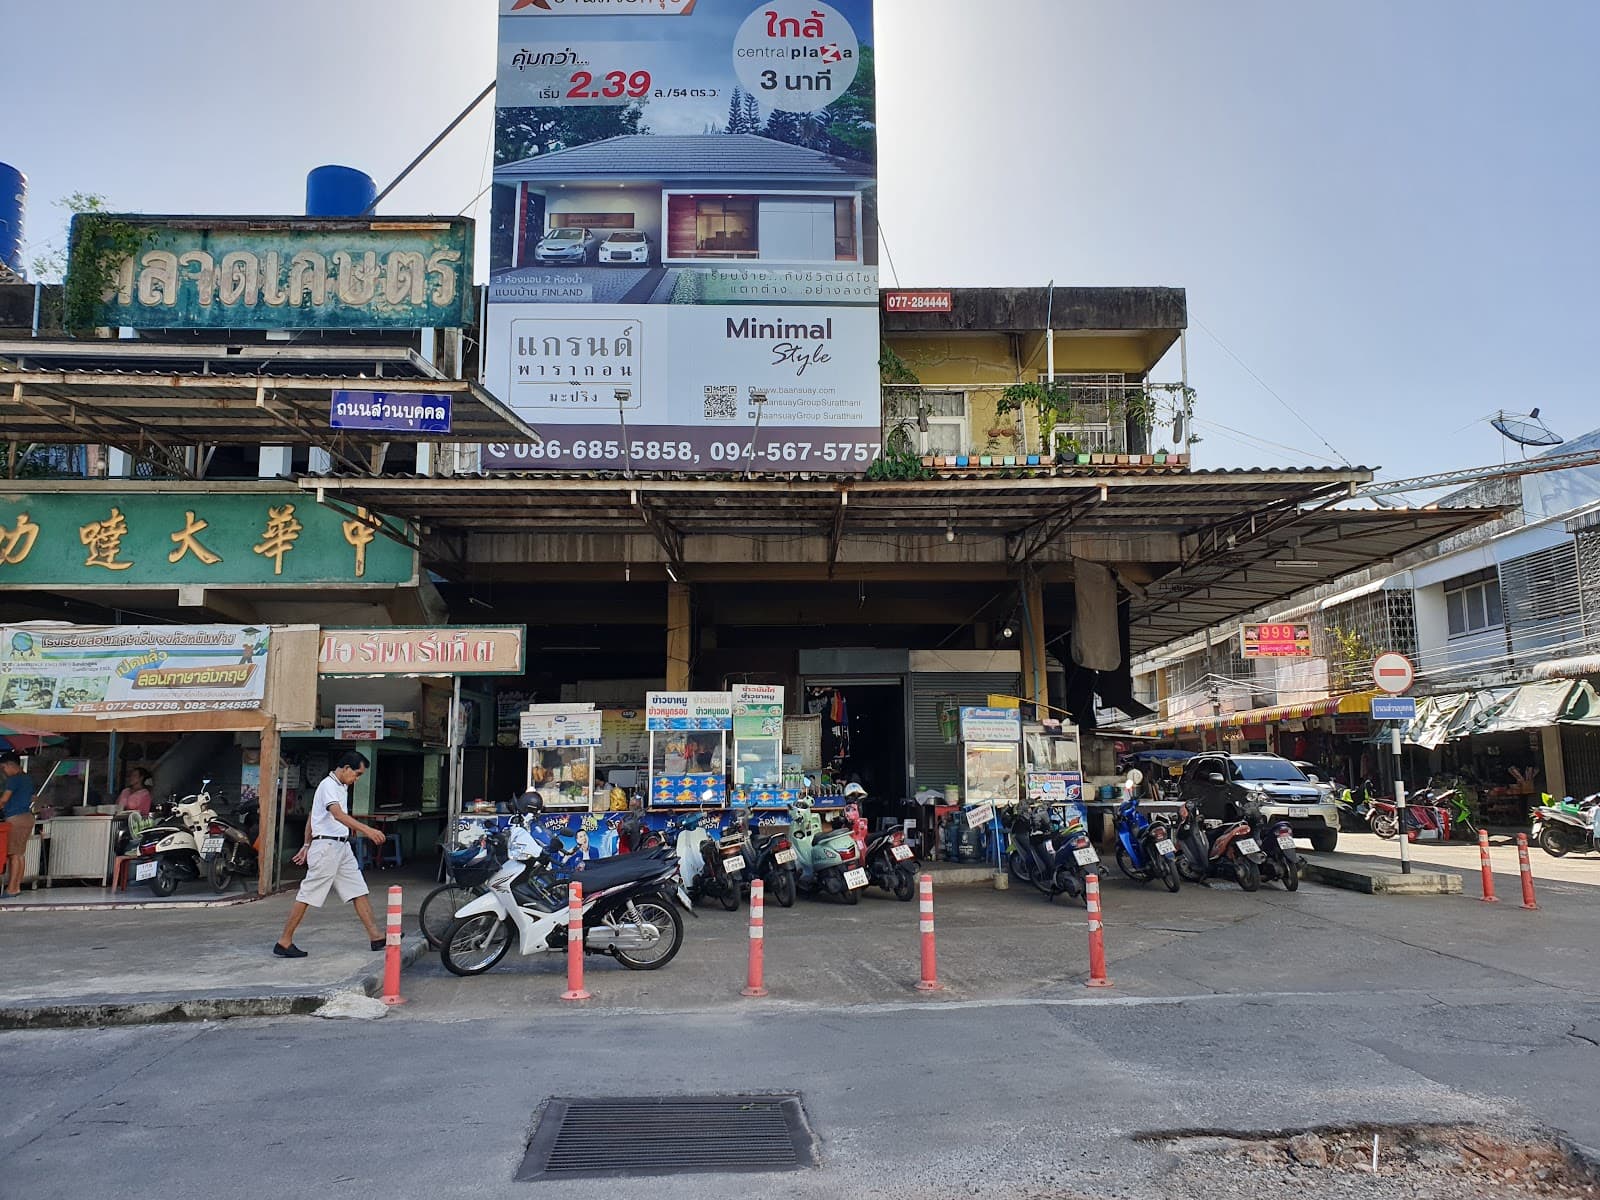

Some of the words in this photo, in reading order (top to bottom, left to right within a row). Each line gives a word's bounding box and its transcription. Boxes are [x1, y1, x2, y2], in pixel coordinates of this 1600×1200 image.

[765, 11, 825, 38] ใกล้
[737, 43, 853, 64] centralplaza
[539, 86, 560, 99] เริ่ม
[566, 71, 651, 99] 2.39
[760, 70, 777, 91] 3
[785, 69, 832, 91] นาที
[495, 286, 538, 297] แบบบ้าน
[541, 288, 583, 297] FINLAND
[888, 295, 949, 308] 077-284444
[726, 318, 832, 340] Minimal
[518, 326, 633, 357] แกรนด์
[771, 342, 832, 376] Style
[518, 365, 633, 377] พารากอน
[549, 391, 598, 403] มะปริง
[761, 398, 862, 408] aansuayGroupSuratthani
[336, 397, 446, 426] ถนนส่วนบุคคล
[513, 439, 701, 464] 086-685-5858,
[710, 441, 881, 462] 094-567-5757
[115, 647, 169, 678] เปิดแล้ว
[137, 668, 248, 688] สอนภาษาอังกฤษ
[78, 703, 96, 712] TEL
[105, 702, 181, 711] 077-603788,
[184, 700, 260, 710] 082-4245552
